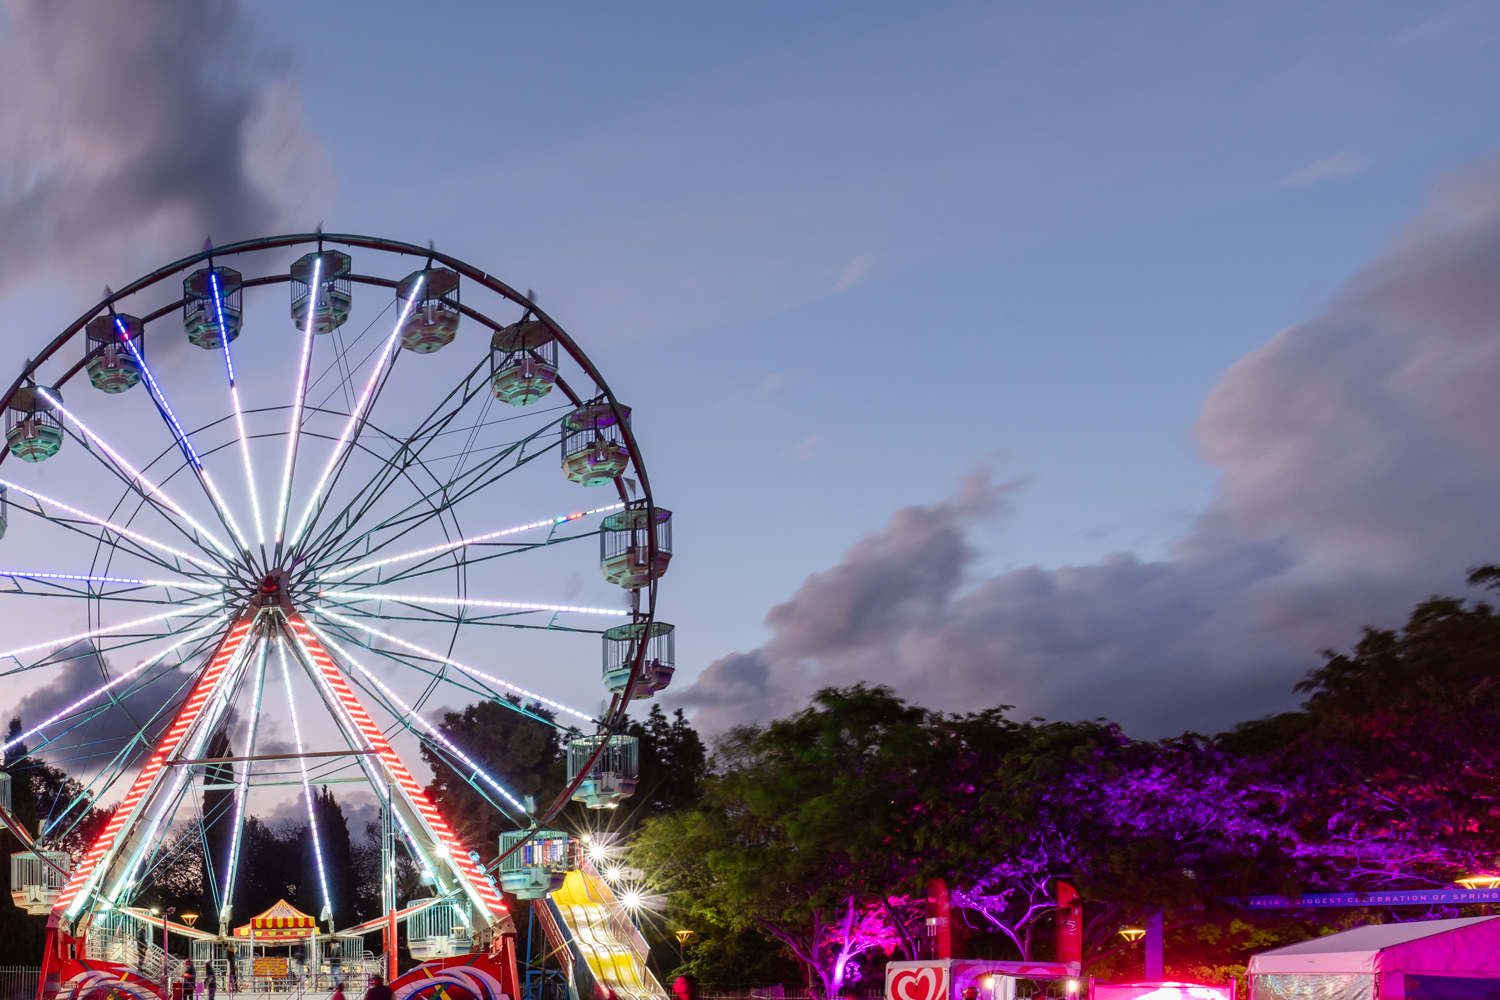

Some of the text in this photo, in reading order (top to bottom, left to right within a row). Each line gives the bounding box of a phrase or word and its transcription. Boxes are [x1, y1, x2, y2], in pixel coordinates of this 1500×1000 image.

[1295, 897, 1342, 905] BIGGEST
[1347, 894, 1427, 904] CELEBRATION
[1432, 893, 1447, 901] OF
[1452, 892, 1499, 900] SPRING
